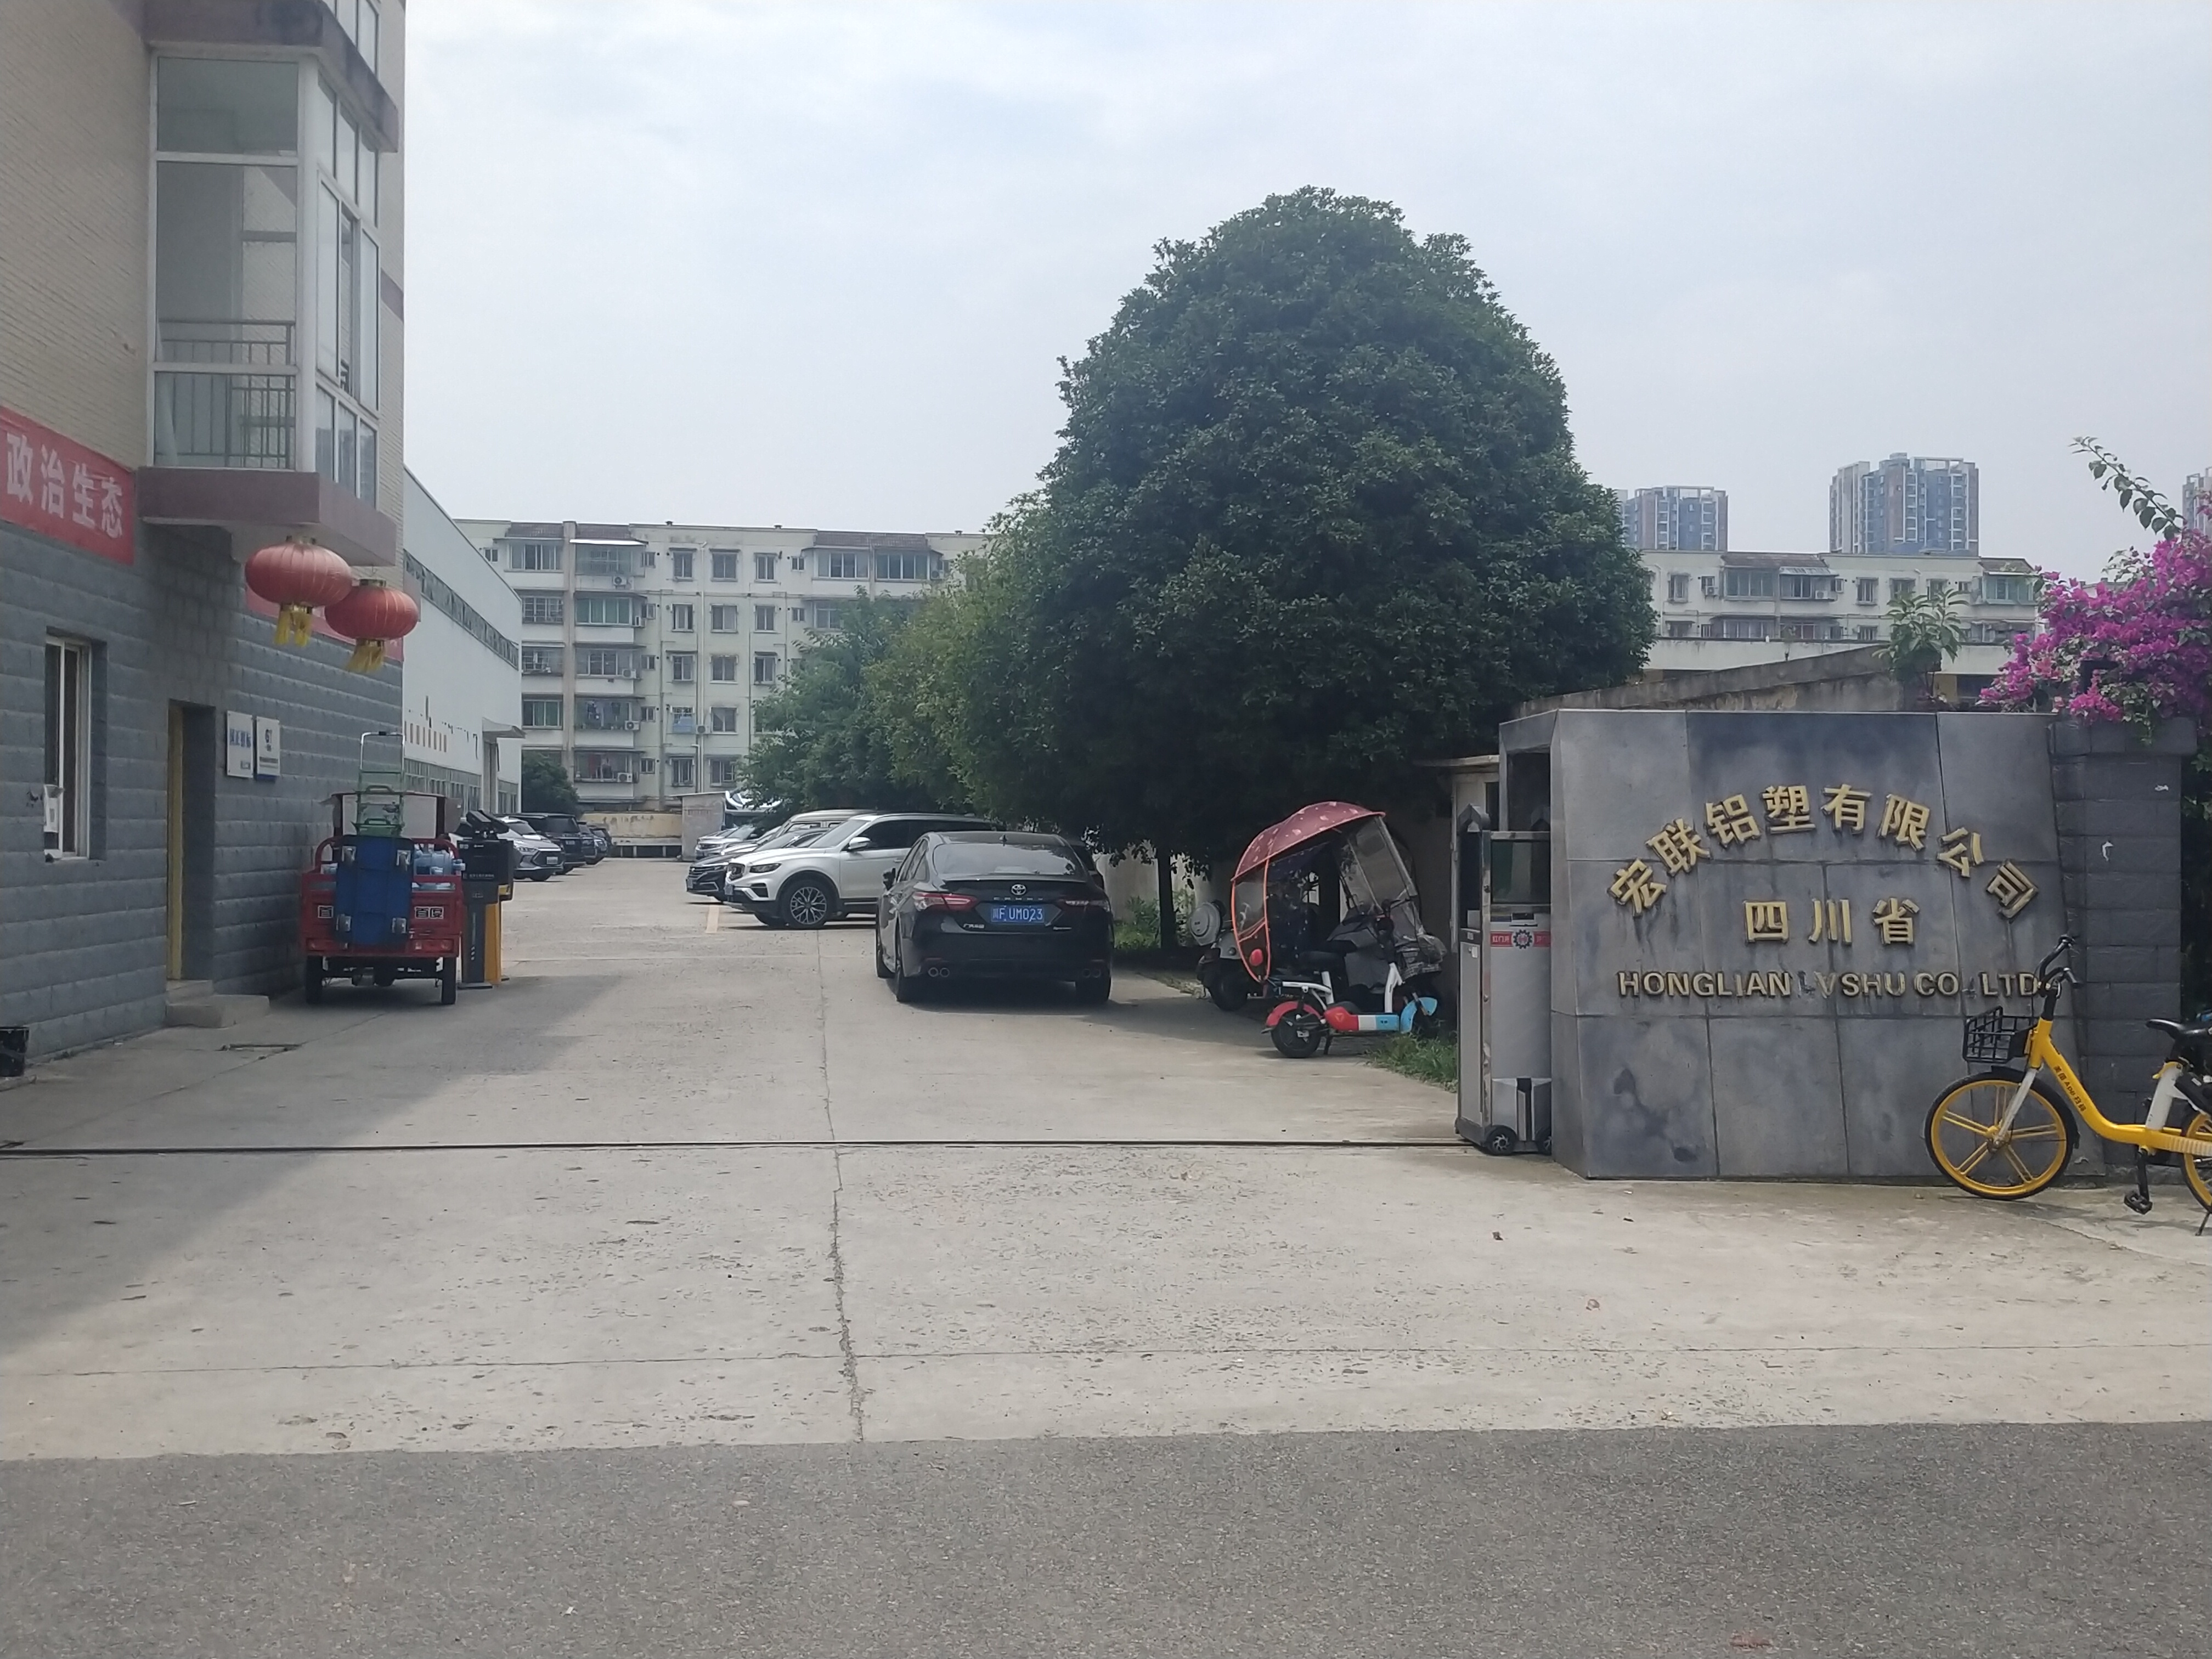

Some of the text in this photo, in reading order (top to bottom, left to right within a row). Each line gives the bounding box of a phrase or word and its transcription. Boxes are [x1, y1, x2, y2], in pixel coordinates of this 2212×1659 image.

[7, 432, 123, 538] 政治生态
[1609, 784, 2039, 917] 宏联铝塑有限公司
[1744, 898, 1920, 945] 四川省
[1618, 970, 1792, 997] HONGLIAN
